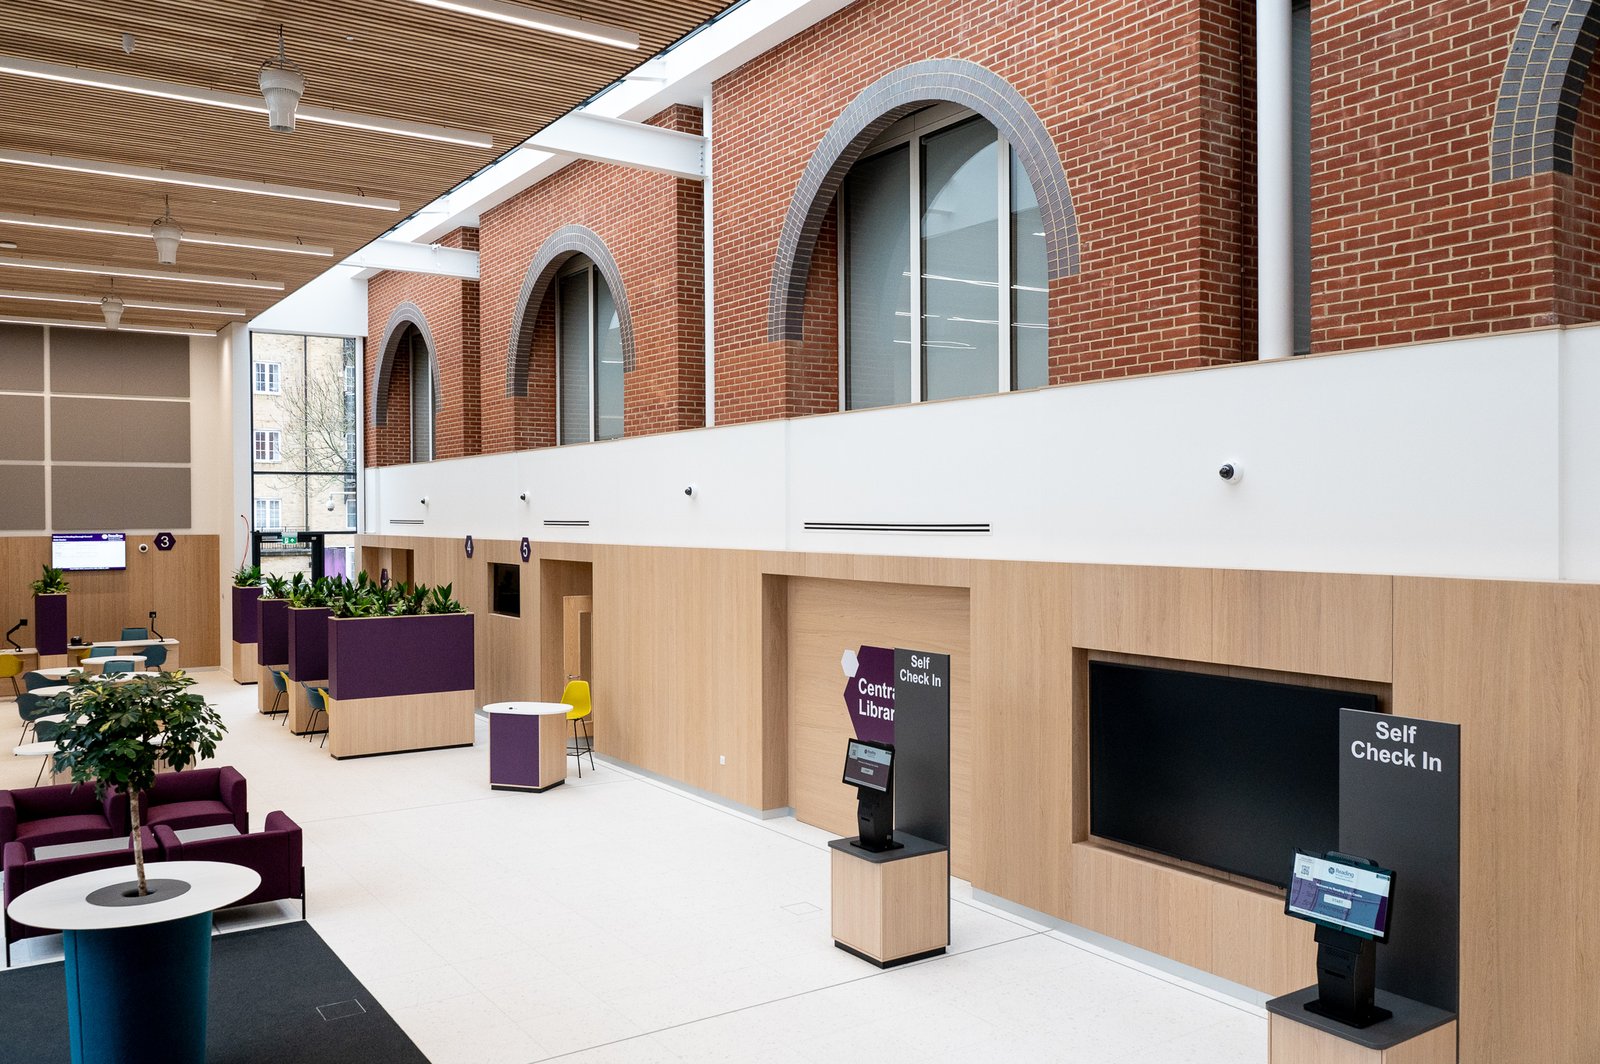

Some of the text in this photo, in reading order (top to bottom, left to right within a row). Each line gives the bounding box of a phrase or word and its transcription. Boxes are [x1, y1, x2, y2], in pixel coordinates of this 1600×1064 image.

[160, 535, 170, 548] 3
[466, 539, 472, 554] 4
[522, 542, 528, 557] 5
[910, 654, 930, 670] Self
[899, 668, 942, 687] Check In
[1375, 721, 1417, 744] Self
[1351, 740, 1442, 772] Check In
